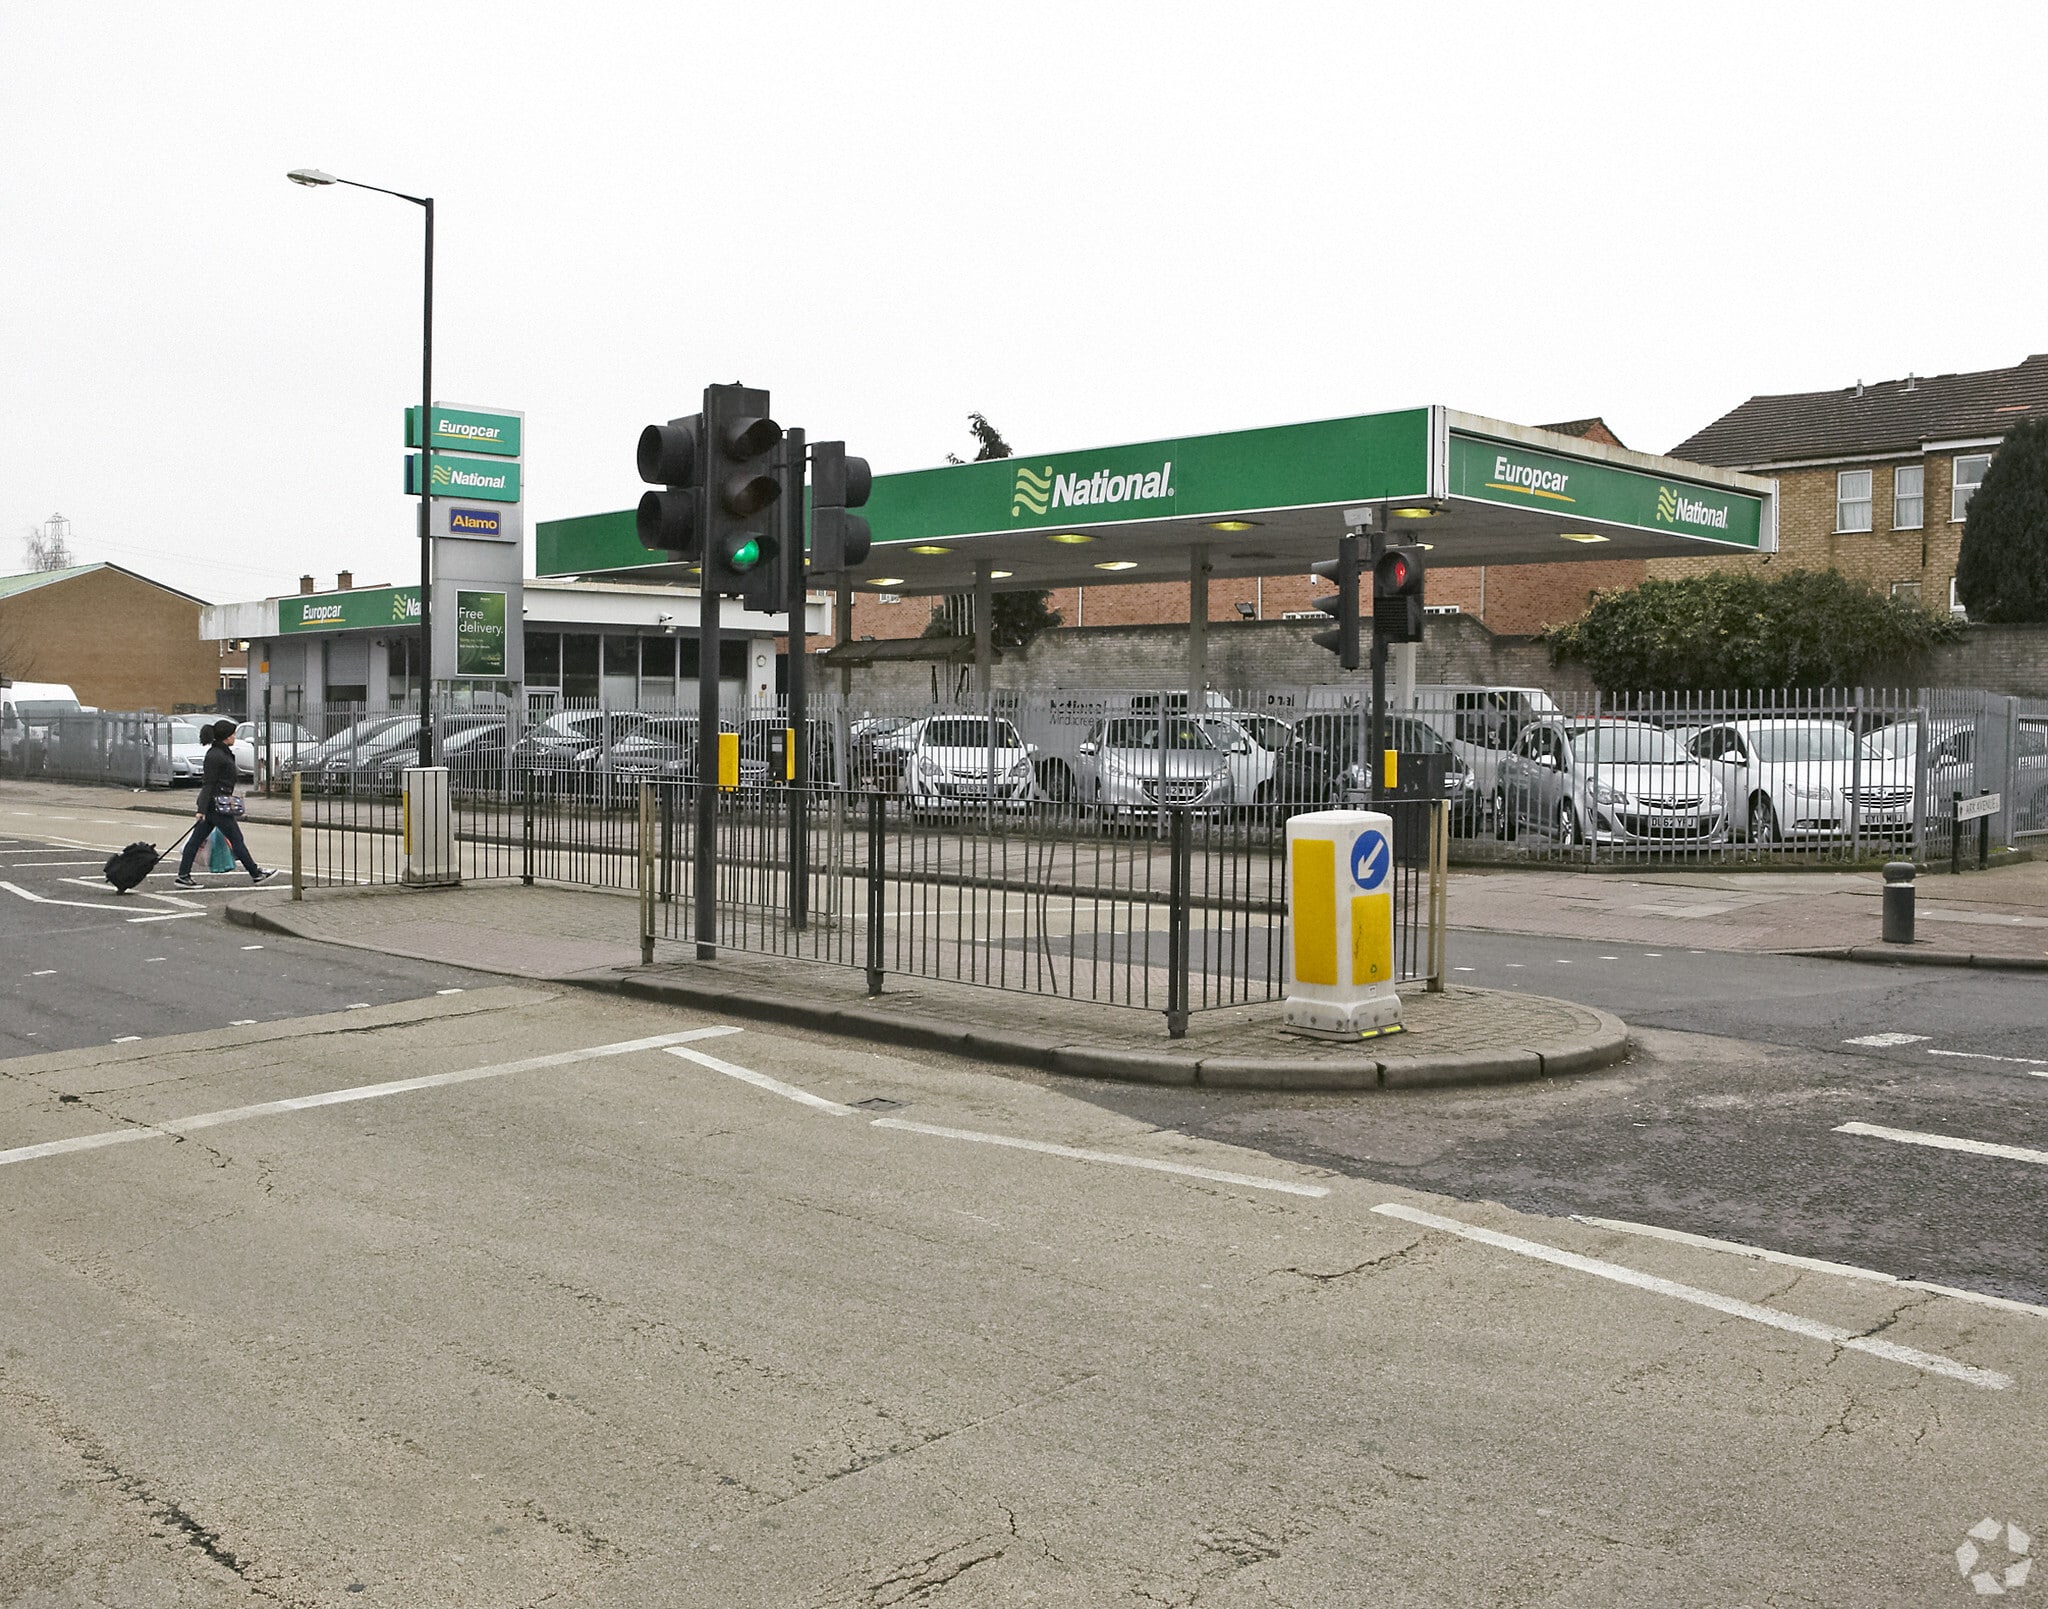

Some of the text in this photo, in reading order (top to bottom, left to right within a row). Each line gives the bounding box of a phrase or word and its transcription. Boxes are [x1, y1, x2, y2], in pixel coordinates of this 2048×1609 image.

[438, 419, 500, 439] Europcar
[450, 470, 505, 489] National
[1051, 461, 1172, 508] National
[1494, 456, 1568, 494] Europcar
[452, 514, 498, 530] Alamo
[1675, 497, 1728, 529] National
[303, 604, 342, 623] Europcar
[459, 607, 484, 620] Free
[459, 620, 504, 637] delivery.
